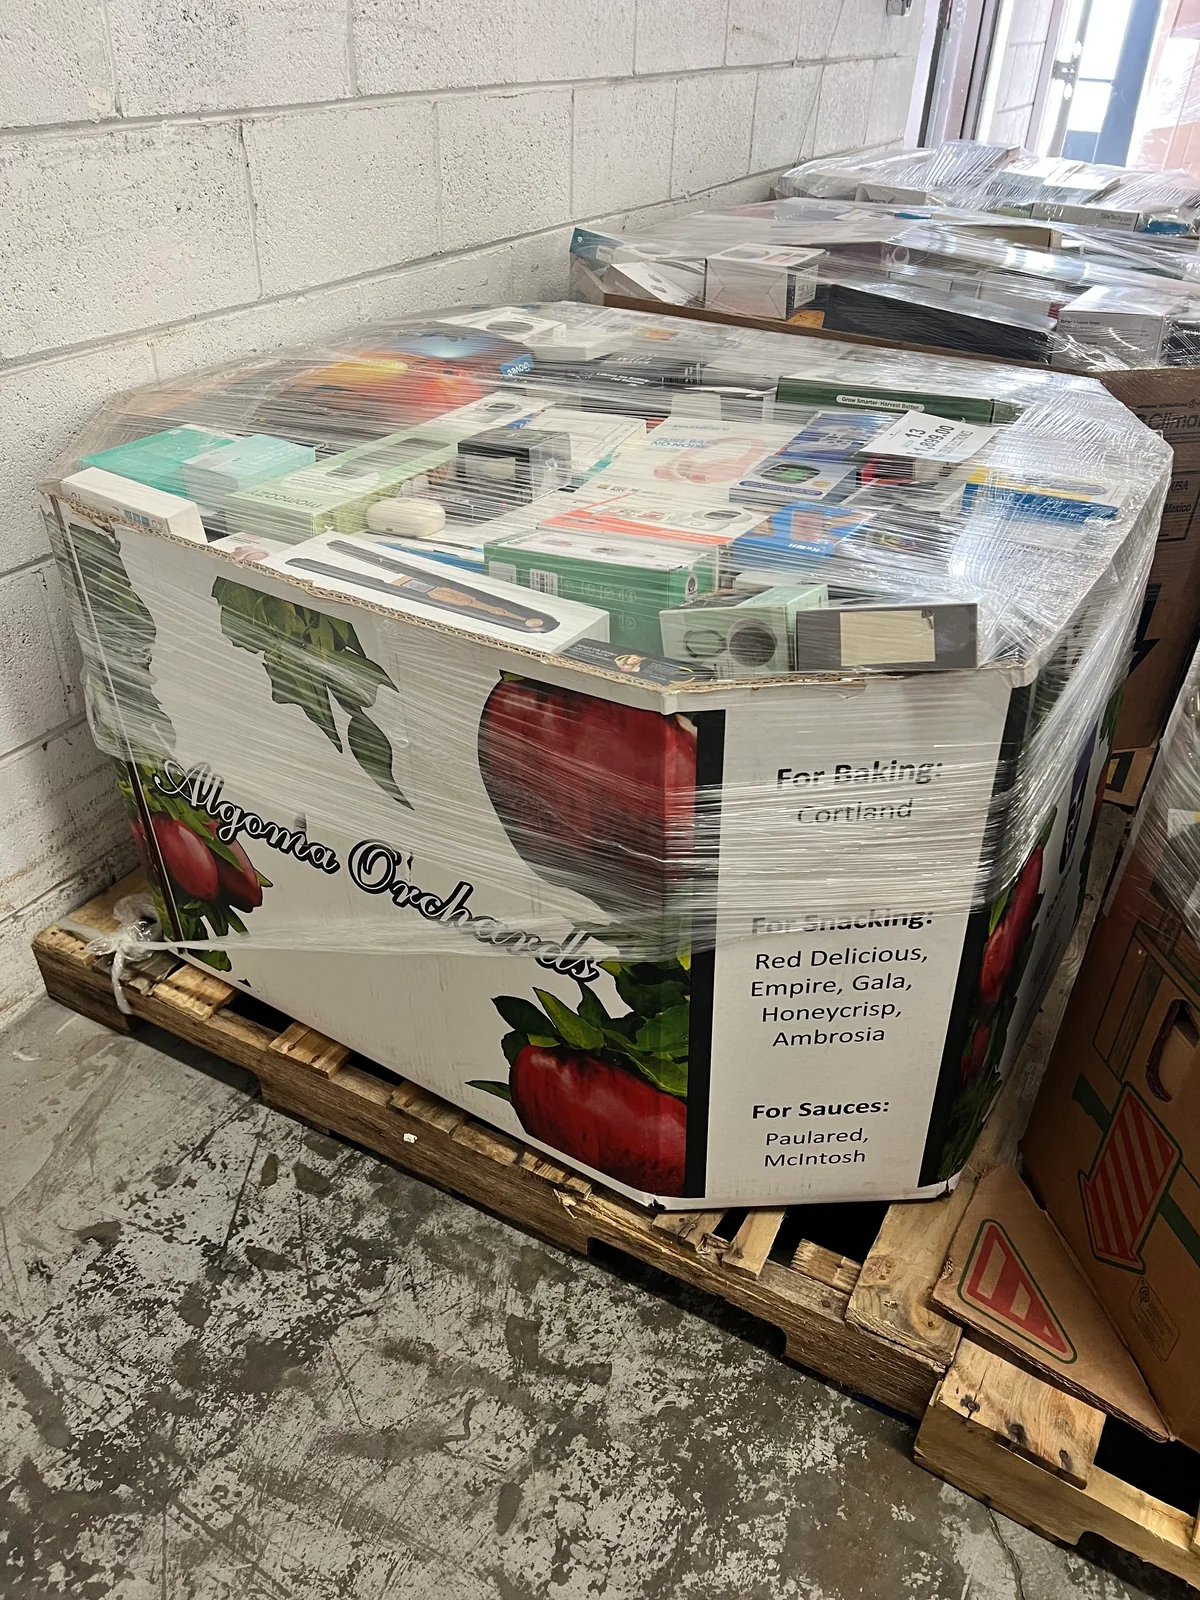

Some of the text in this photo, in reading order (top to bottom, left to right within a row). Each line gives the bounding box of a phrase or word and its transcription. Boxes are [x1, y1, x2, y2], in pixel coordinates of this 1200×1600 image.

[507, 361, 531, 376] Govee
[905, 428, 926, 438] 13
[250, 489, 324, 509] momcozy
[776, 759, 943, 789] For Baking:
[153, 759, 340, 874] Algoma
[797, 797, 913, 825] Cortland
[348, 837, 600, 981] Orchards
[752, 908, 934, 934] For Snacking:
[755, 947, 928, 970] Red Delicious,
[751, 972, 912, 998] Empire, Gala,
[762, 1001, 902, 1023] Honeycrisp,
[772, 1026, 886, 1047] Ambrosia
[752, 1100, 890, 1119] For Sauces:
[766, 1127, 869, 1146] Paulared,
[764, 1149, 866, 1167] McIntosh
